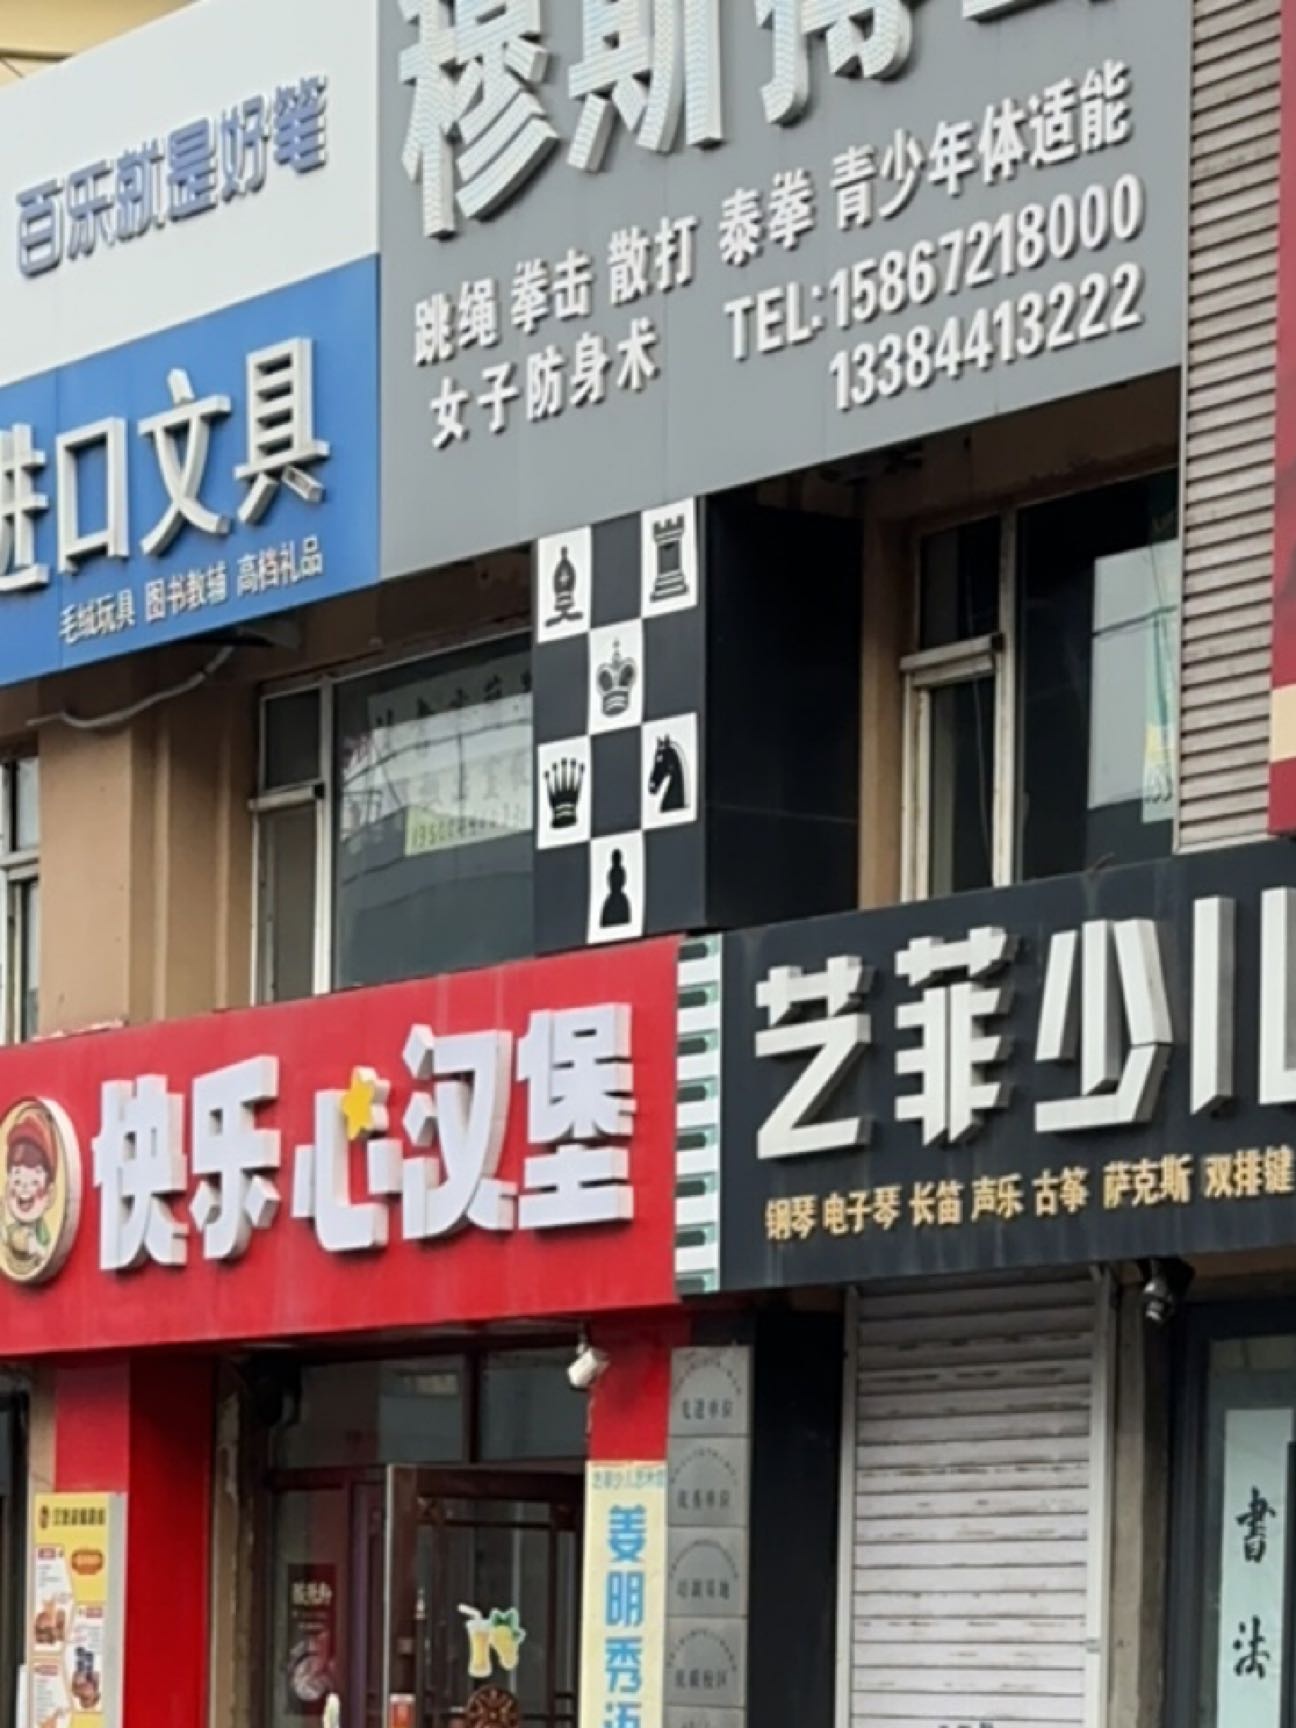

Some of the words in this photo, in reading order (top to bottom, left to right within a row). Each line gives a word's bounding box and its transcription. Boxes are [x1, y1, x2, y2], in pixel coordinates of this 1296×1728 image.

[400, 0, 1066, 238] 穆斯
[414, 278, 501, 366] 跳绳
[510, 248, 595, 336] 拳击
[607, 214, 700, 306] 散打
[717, 171, 818, 266] 泰拳
[829, 59, 1132, 230] 青少年体适能
[724, 173, 1145, 360] TEL:15867218000
[430, 319, 660, 450] 女子防身术
[829, 263, 1146, 411] 13384413222
[236, 534, 324, 597] 高档礼品
[93, 1003, 637, 1271] 快乐心汉堡
[765, 1196, 817, 1240] 钢琴
[822, 1187, 901, 1236] 电子琴
[910, 1180, 963, 1227] 长笛
[971, 1173, 1023, 1222] 声乐
[1033, 1165, 1090, 1218] 古筝
[1103, 1154, 1193, 1209] 萨克斯
[1204, 1144, 1296, 1199] 双排键
